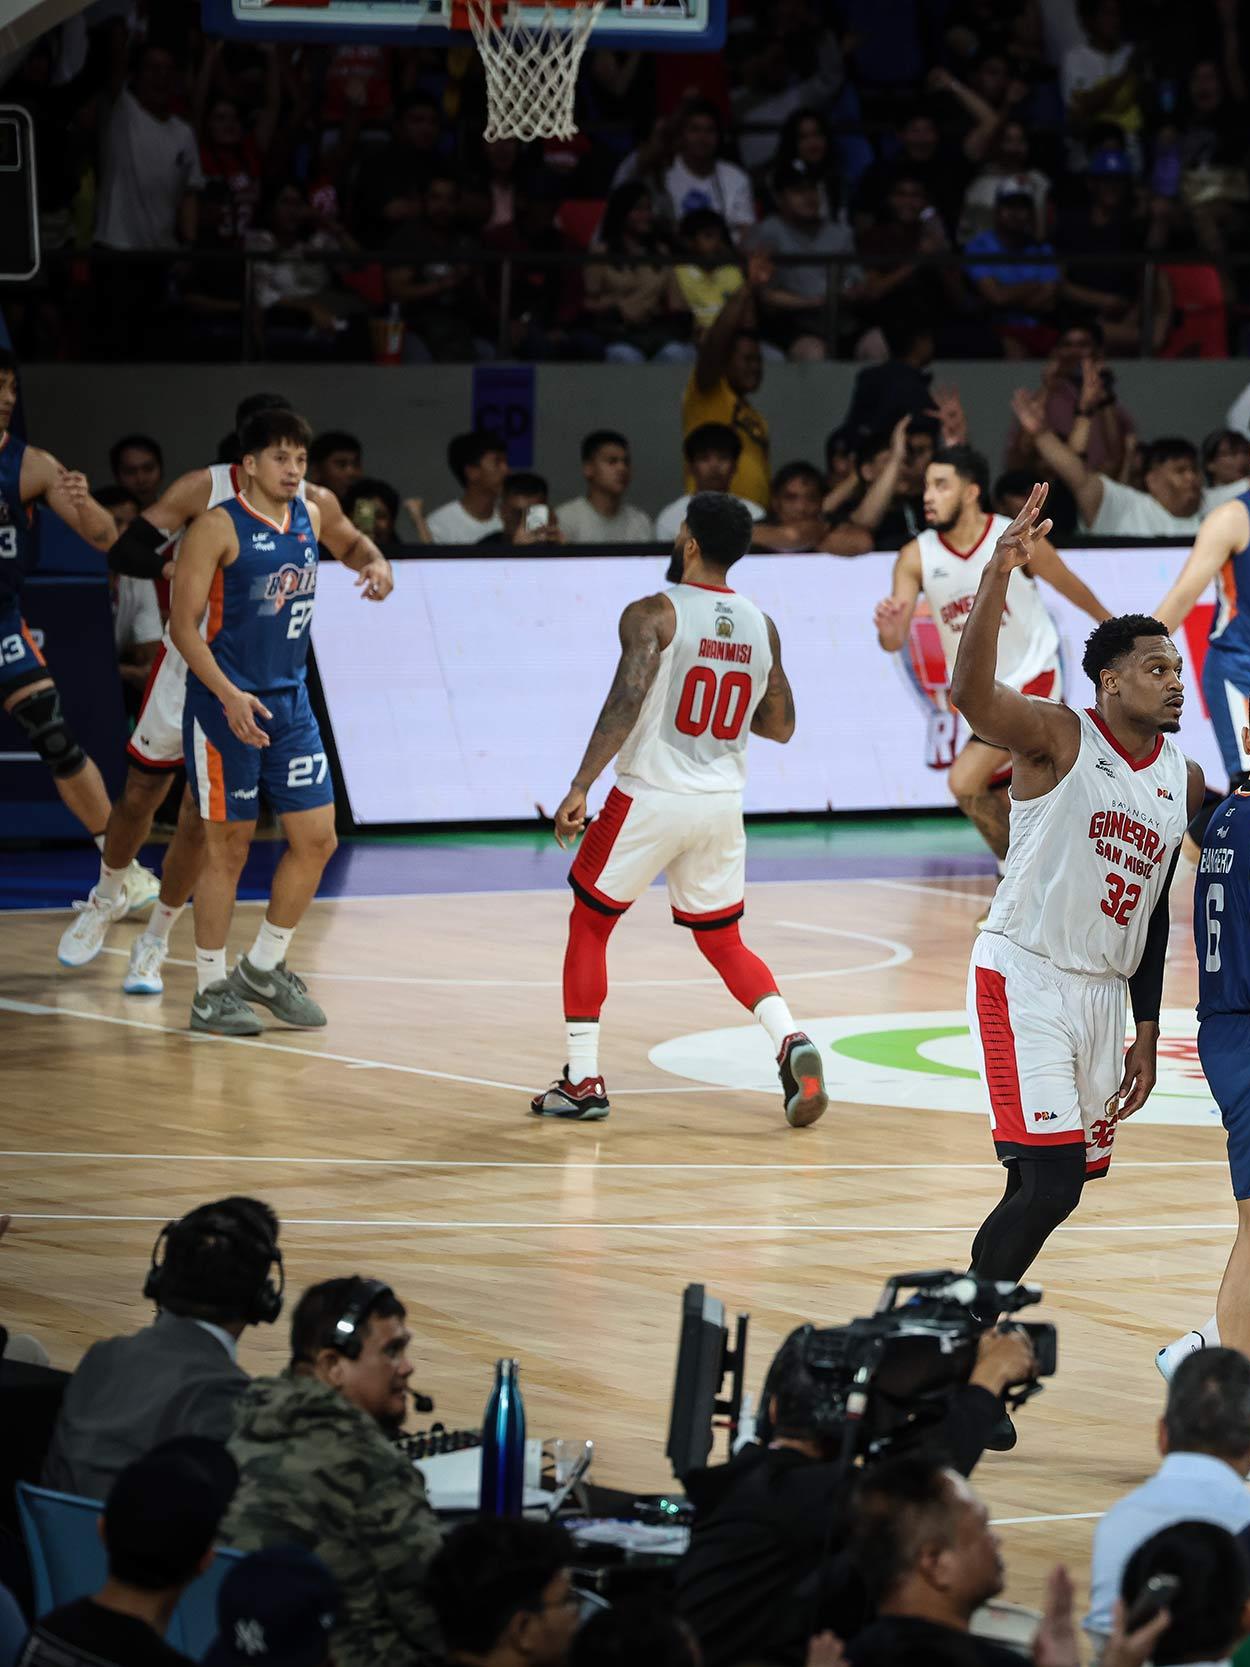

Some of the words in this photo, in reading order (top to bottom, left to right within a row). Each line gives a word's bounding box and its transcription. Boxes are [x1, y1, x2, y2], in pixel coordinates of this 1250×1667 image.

[0, 525, 17, 558] 3
[674, 665, 752, 740] 00
[286, 753, 328, 788] 27
[1157, 788, 1174, 801] PBA
[1095, 839, 1123, 866] SAN
[1100, 872, 1142, 926] 32
[1205, 883, 1224, 972] 6
[1034, 1111, 1058, 1122] PBA
